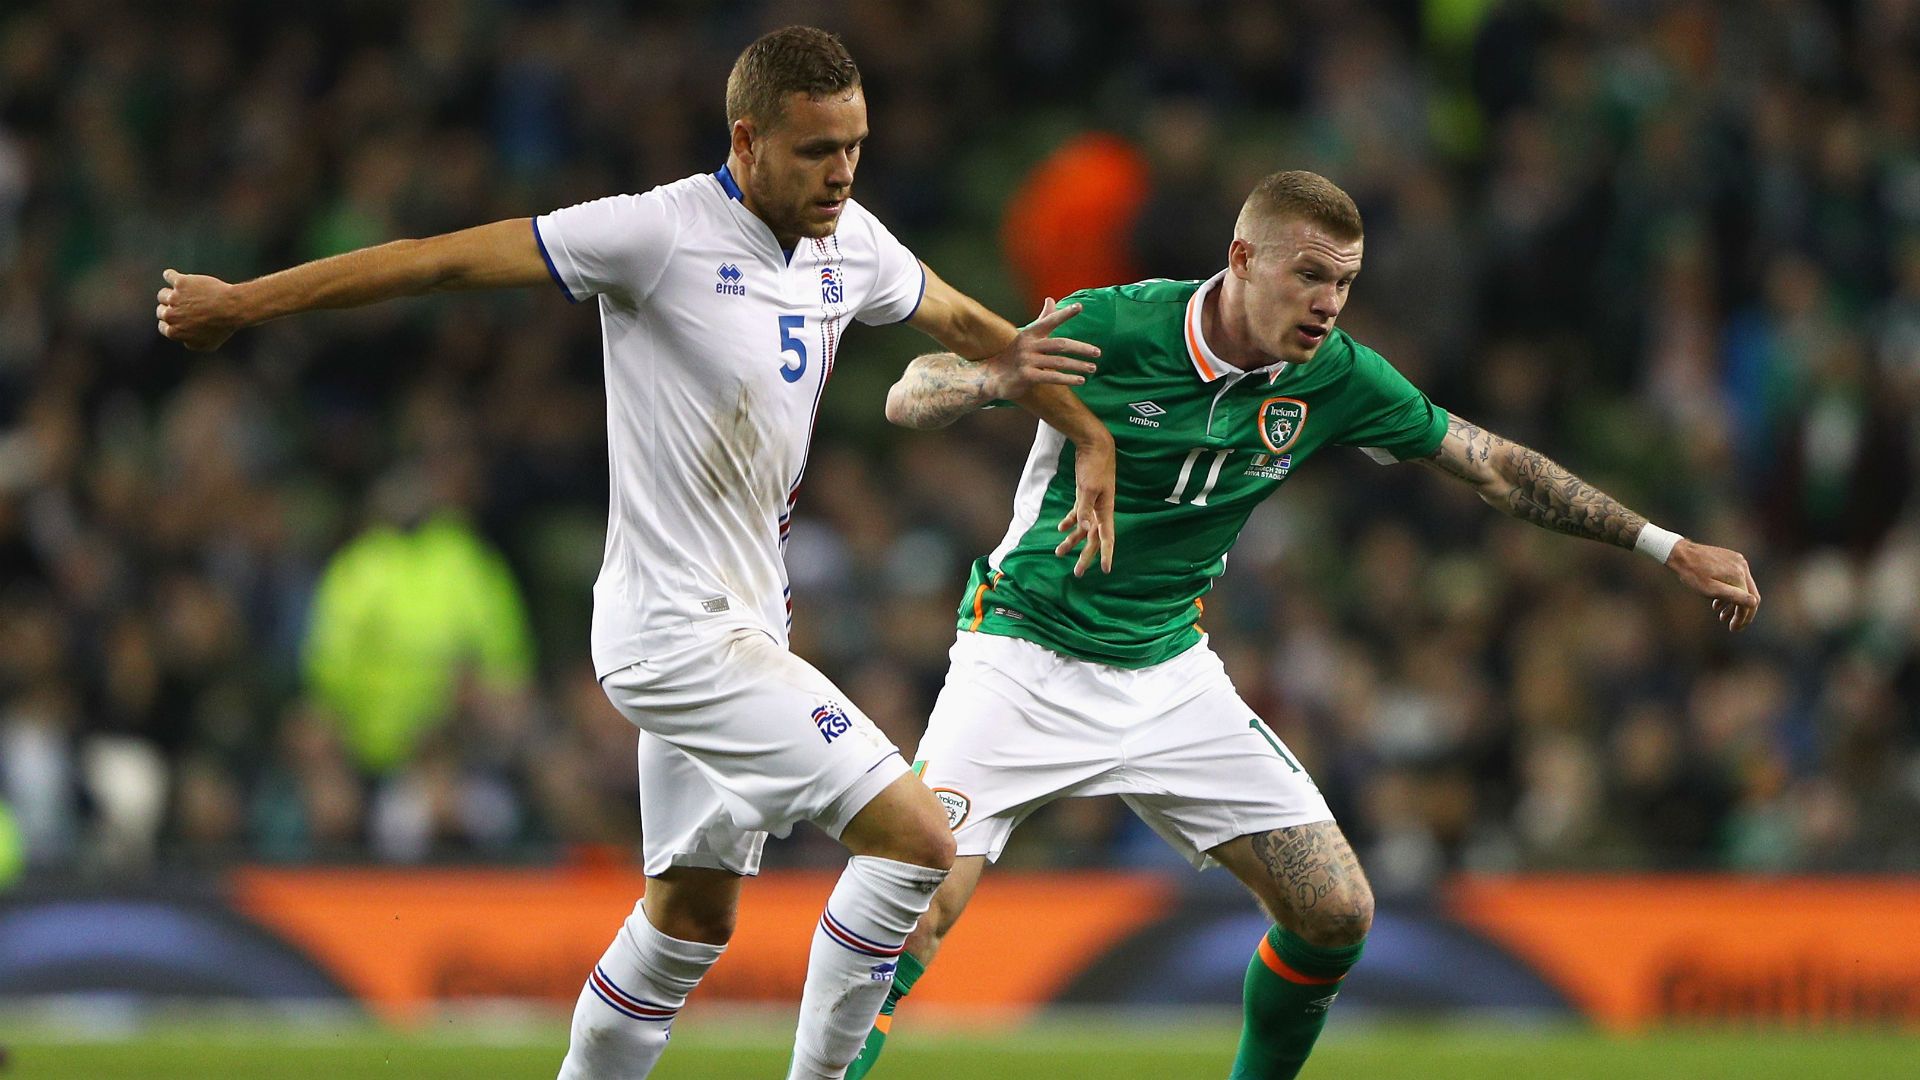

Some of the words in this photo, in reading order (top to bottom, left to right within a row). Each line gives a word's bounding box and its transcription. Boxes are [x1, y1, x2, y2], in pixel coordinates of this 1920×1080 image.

[778, 315, 808, 384] 5
[1129, 416, 1160, 428] umbro
[1270, 405, 1299, 418] Ireland
[1164, 447, 1236, 506] 11
